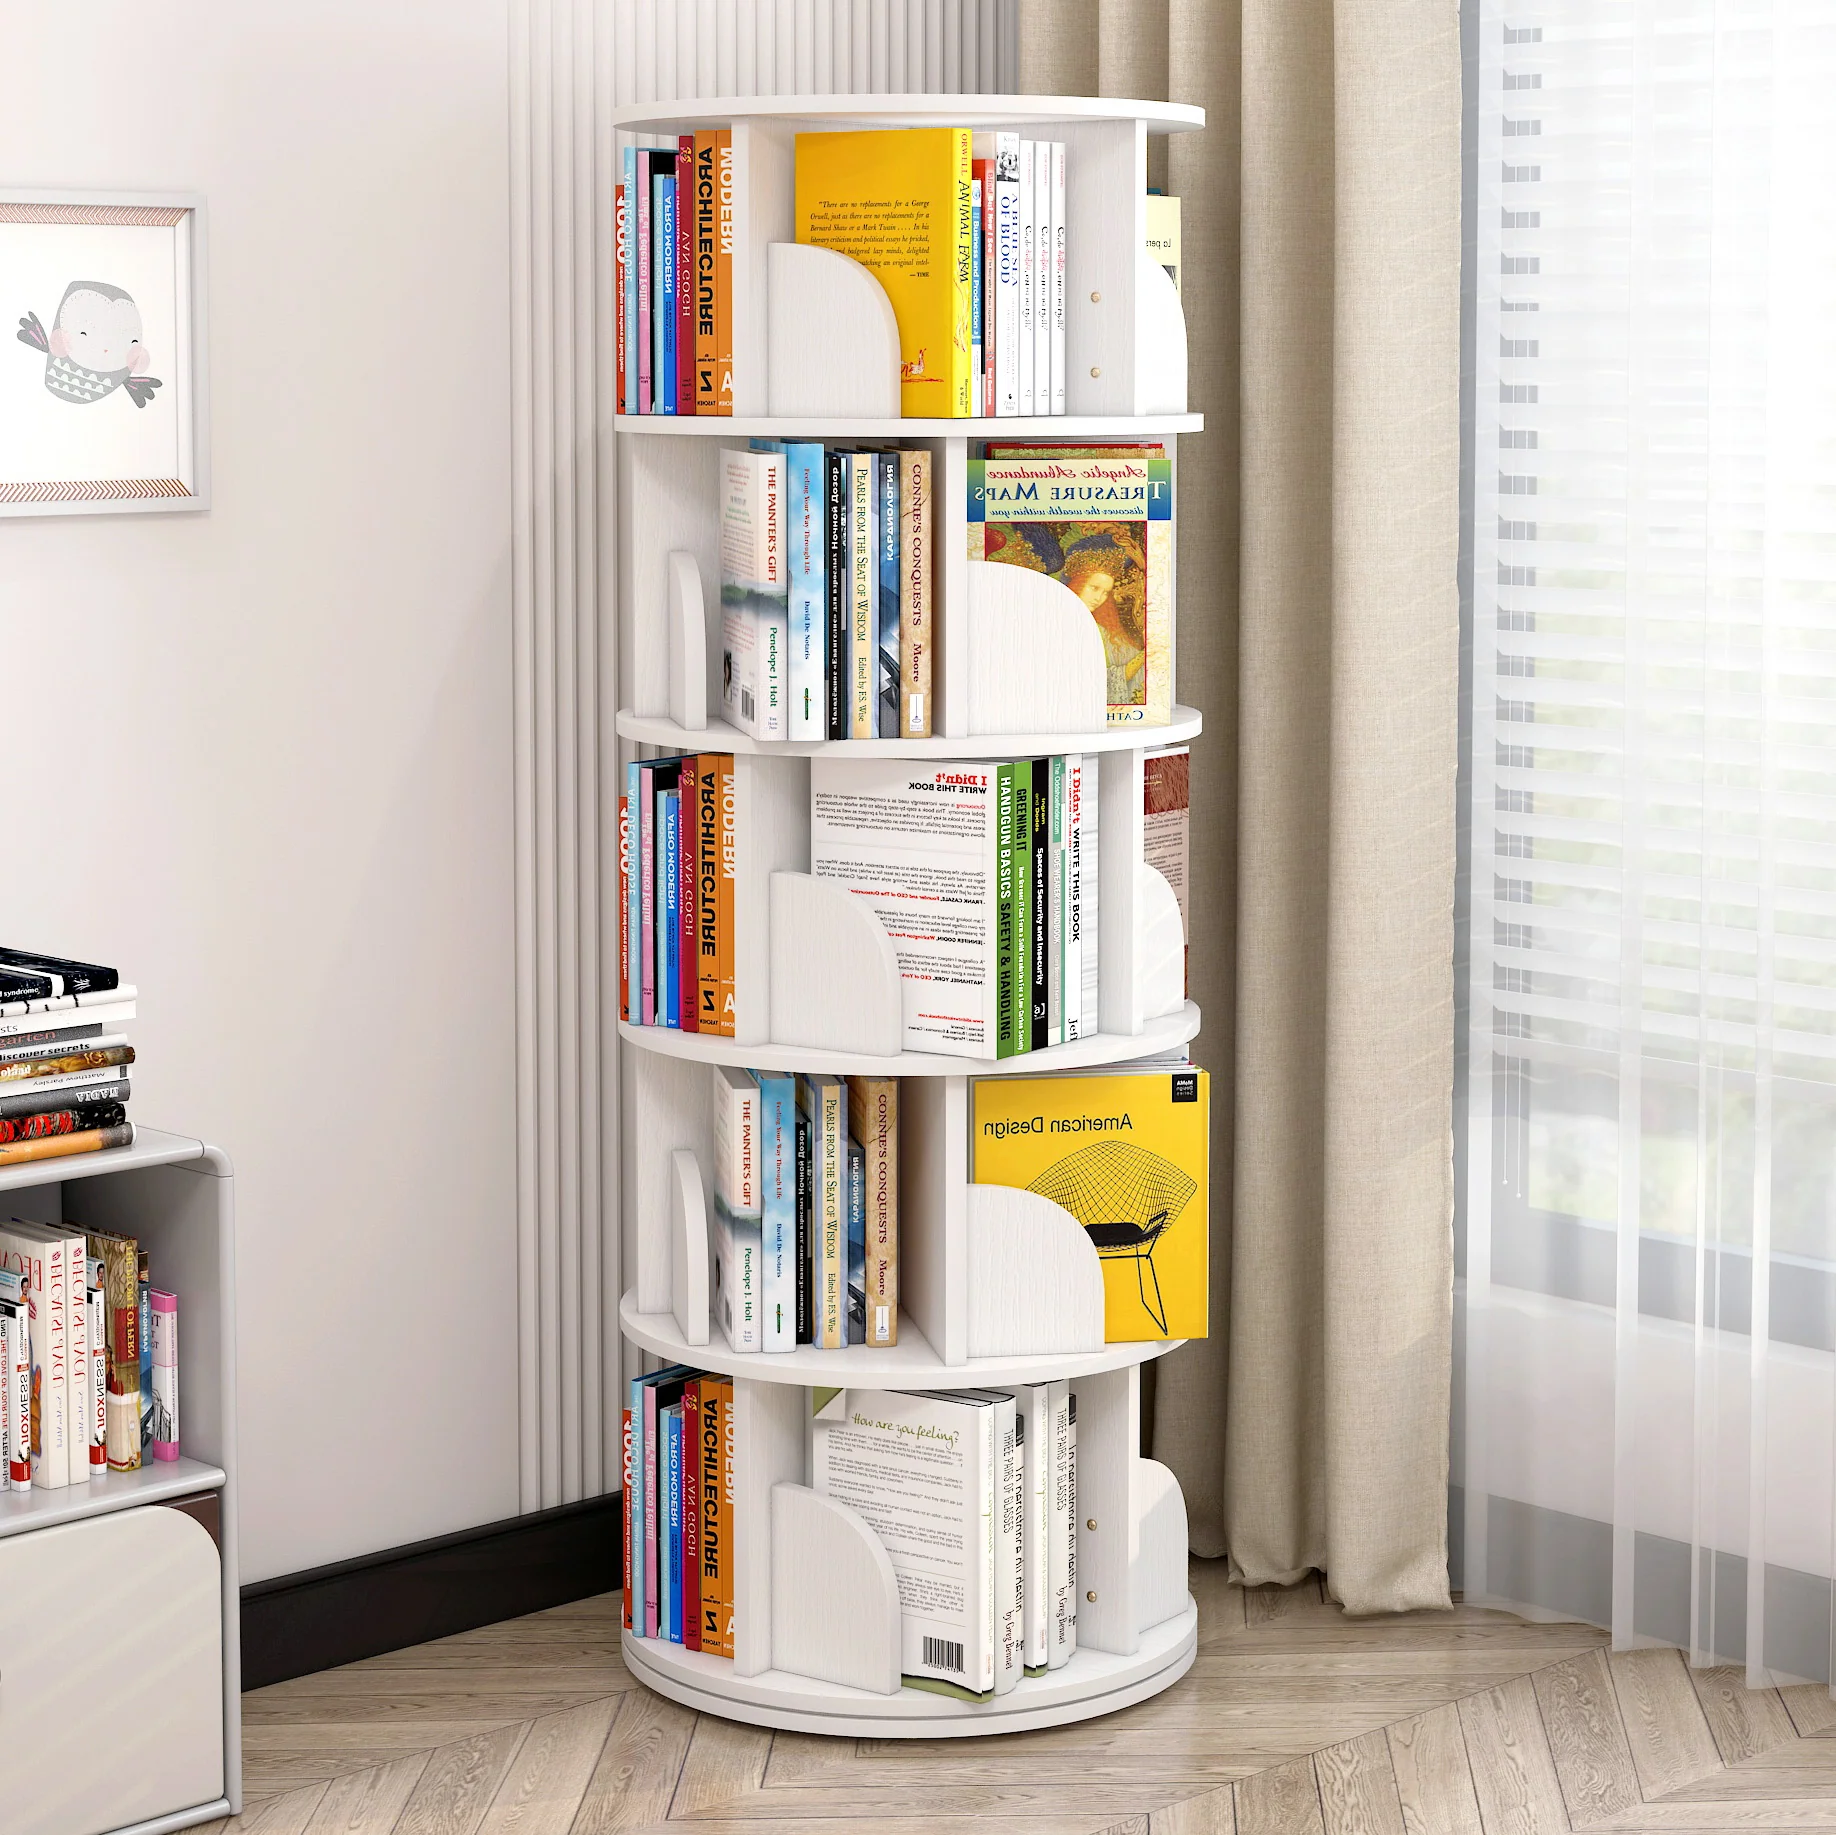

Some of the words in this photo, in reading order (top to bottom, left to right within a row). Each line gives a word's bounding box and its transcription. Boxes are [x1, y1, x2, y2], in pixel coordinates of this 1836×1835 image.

[960, 134, 968, 176] ORWELL
[860, 201, 892, 209] replacements
[911, 200, 929, 209] George
[958, 180, 970, 239] ANIMAL
[1000, 196, 1010, 218] OF
[958, 244, 970, 283] FARM
[1000, 224, 1010, 284] BLOOD
[768, 466, 776, 490] THE
[831, 467, 839, 502] Дозор
[886, 464, 894, 560] КАРДИОЛОГИЯ
[912, 464, 922, 534] CONNIE'S
[768, 494, 776, 552] PAINTER'S
[857, 506, 866, 532] FROM
[857, 536, 866, 554] THE
[768, 556, 776, 582] GIFT
[911, 538, 922, 626] CONQUESTS
[857, 584, 866, 596] OF
[768, 628, 778, 672] Penelope
[913, 644, 922, 682] Moore
[858, 657, 866, 680] Edited
[770, 686, 778, 706] Holt
[858, 682, 866, 690] by
[858, 704, 866, 722] Wise
[1000, 776, 1011, 845] HANDGUN
[1016, 788, 1026, 839] GREENING
[1072, 778, 1080, 824] Didn't
[1016, 842, 1026, 851] IT
[1072, 828, 1080, 868] WRITE
[1000, 849, 1011, 899] BASICS
[1036, 848, 1044, 878] Spaces
[1037, 880, 1044, 888] of
[1072, 871, 1080, 900] THIS
[1036, 889, 1044, 925] Security
[1000, 902, 1010, 951] SAFETY
[1072, 904, 1080, 942] BOOK
[1000, 957, 1010, 966] &
[1036, 942, 1044, 986] Insecurity
[4, 987, 39, 997] syndrome
[1000, 970, 1010, 1040] HANDLING
[0, 1031, 56, 1048] garten
[48, 1044, 90, 1054] secrets
[742, 1100, 751, 1122] THE
[878, 1094, 887, 1158] CONNIE'S
[742, 1124, 751, 1179] PAINTER'S
[826, 1134, 836, 1158] FROM
[826, 1161, 836, 1178] THE
[743, 1182, 752, 1207] GIFT
[852, 1156, 860, 1223] КАРДИОЛОГИЯ
[877, 1162, 887, 1244] CONQUESTS
[827, 1208, 836, 1218] OF
[879, 1260, 888, 1296] Moore
[852, 1413, 874, 1428] How
[876, 1421, 894, 1431] are
[896, 1424, 916, 1438] you
[916, 1425, 960, 1450] feeling?
[1057, 1408, 1066, 1436] THREE
[1004, 1428, 1014, 1456] THREE
[1057, 1436, 1066, 1460] PAIRS
[1004, 1457, 1014, 1482] PAIRS
[1057, 1461, 1066, 1472] OF
[1004, 1483, 1014, 1494] OF
[1057, 1474, 1066, 1510] GLASSES
[1004, 1496, 1014, 1534] GLASSES
[1056, 1597, 1068, 1618] Greg
[1002, 1622, 1014, 1642] Greg
[1058, 1616, 1068, 1644] Bennet
[1006, 1642, 1014, 1670] Bennet
